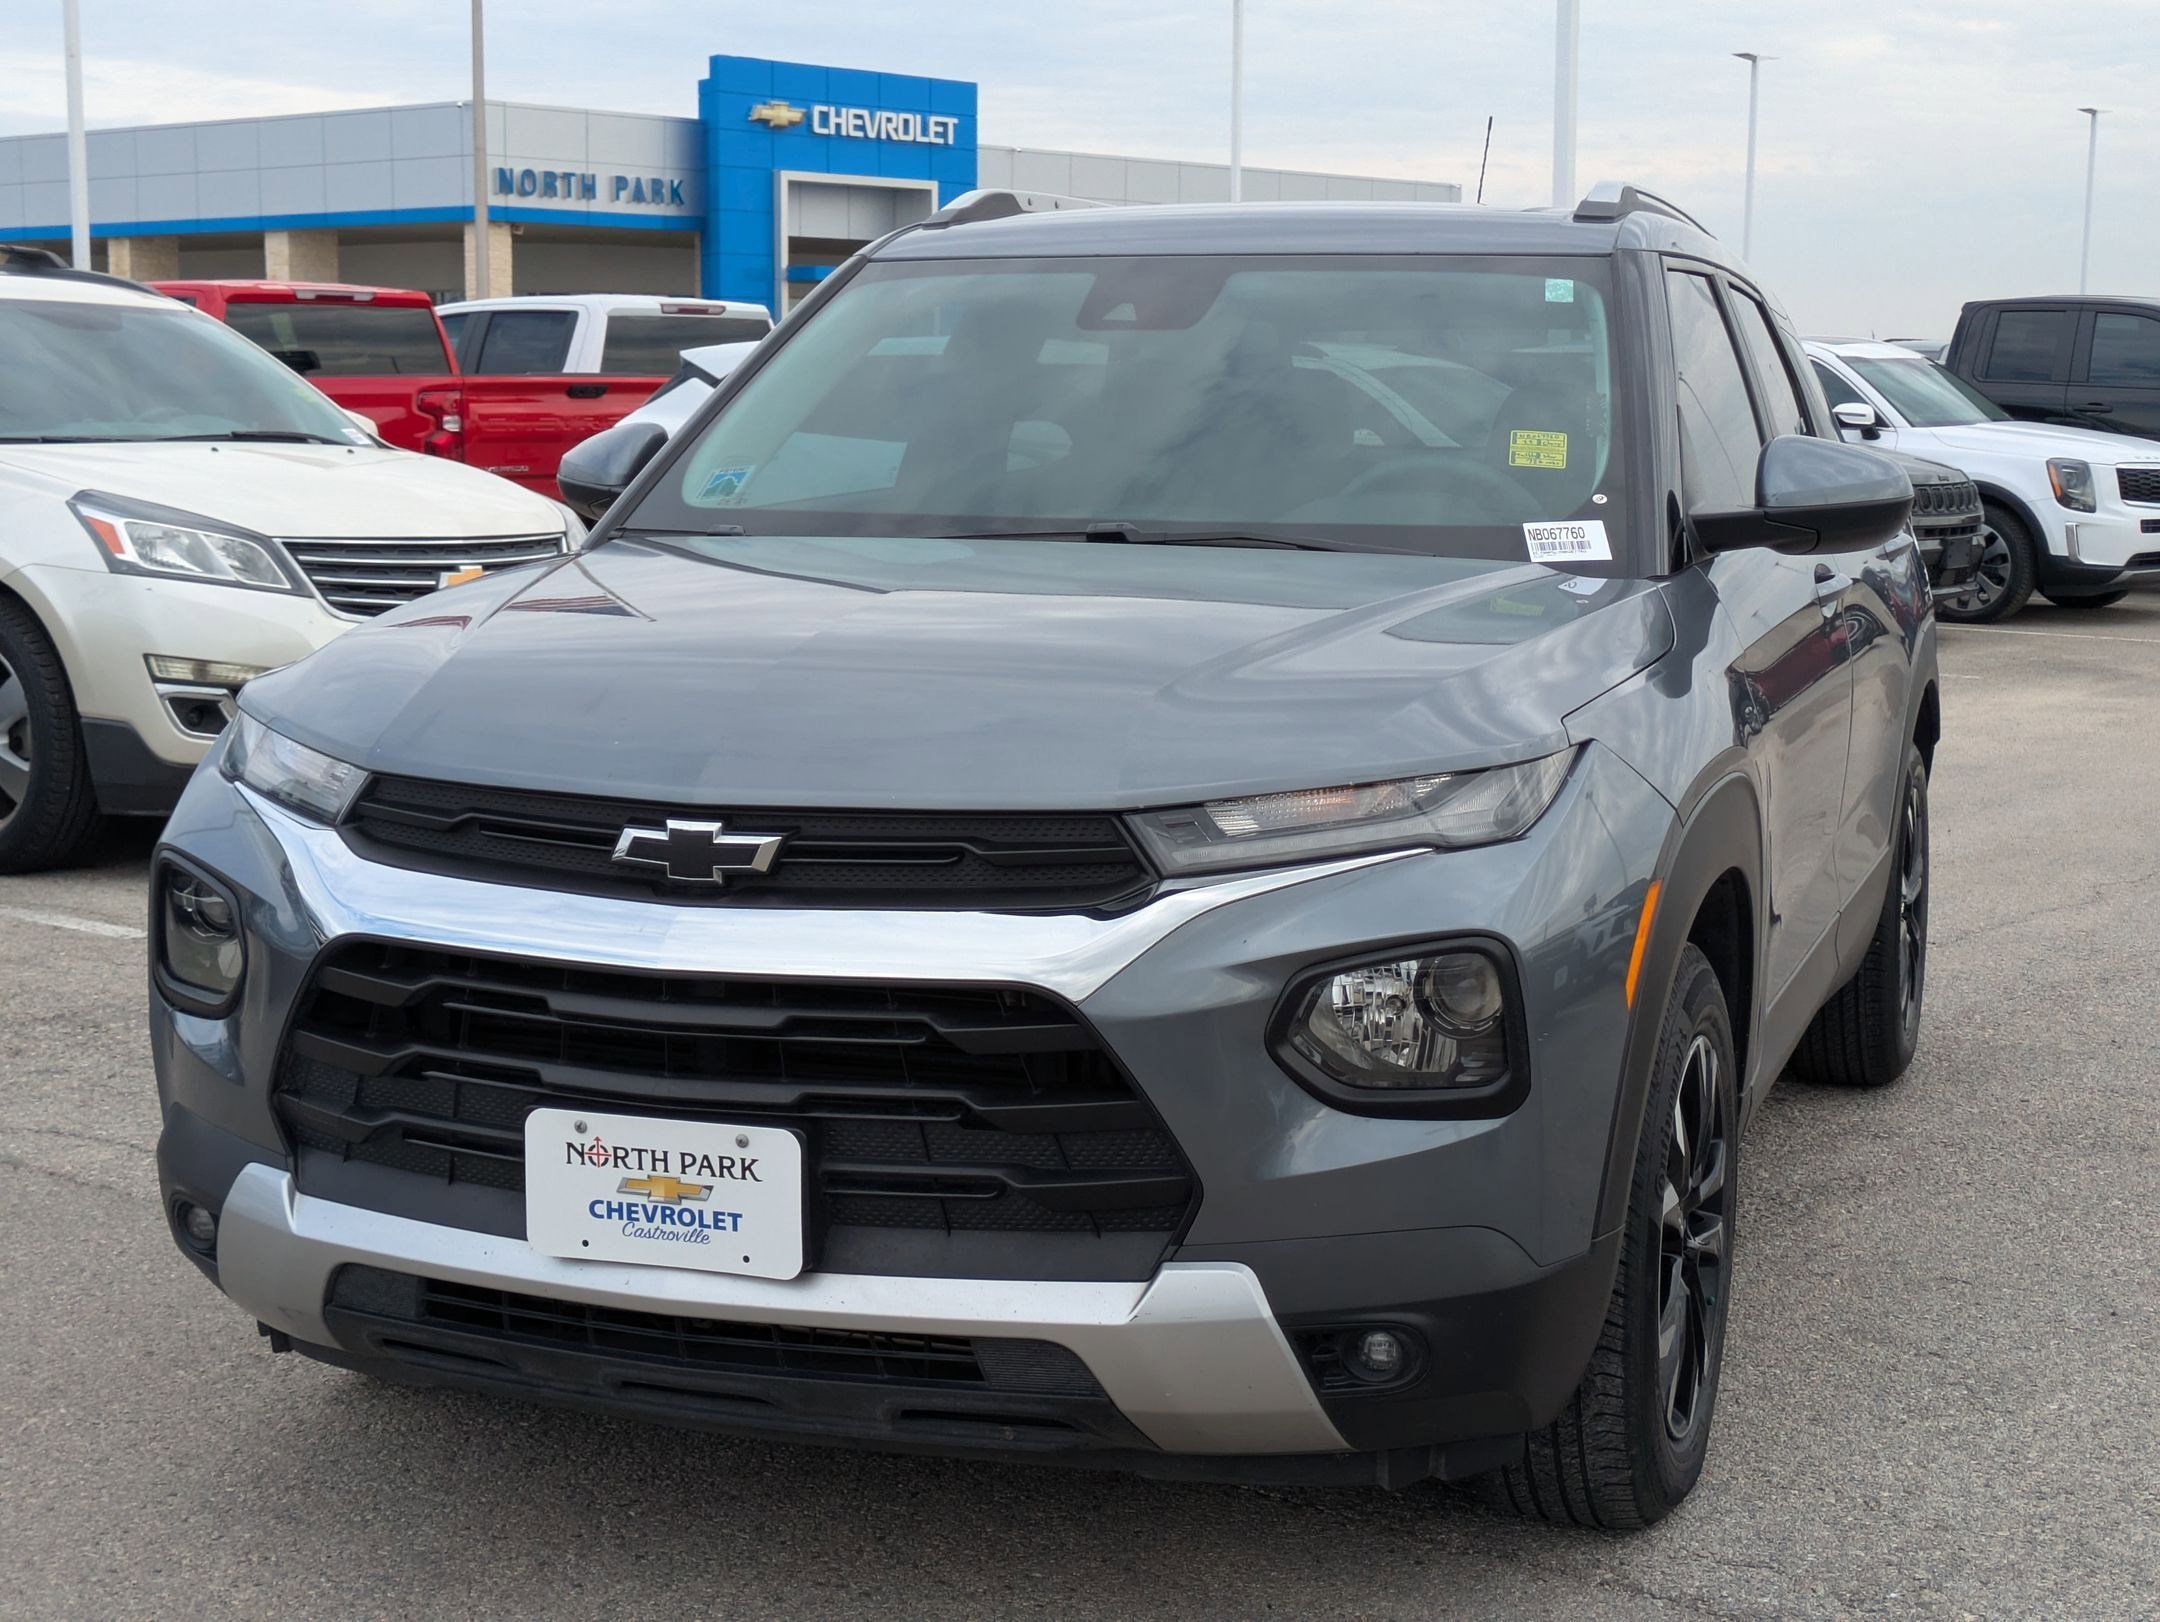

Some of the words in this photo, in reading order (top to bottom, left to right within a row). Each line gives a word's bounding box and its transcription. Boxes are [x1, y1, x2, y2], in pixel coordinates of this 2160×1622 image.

[812, 104, 958, 145] CHEVROLET
[495, 166, 597, 200] NORTH
[612, 174, 686, 206] PARK
[1527, 526, 1586, 541] NB067760
[565, 1138, 670, 1173] NORTH
[679, 1151, 763, 1182] PARK
[588, 1199, 743, 1232] CHEVROLET
[621, 1221, 711, 1245] Castroville
